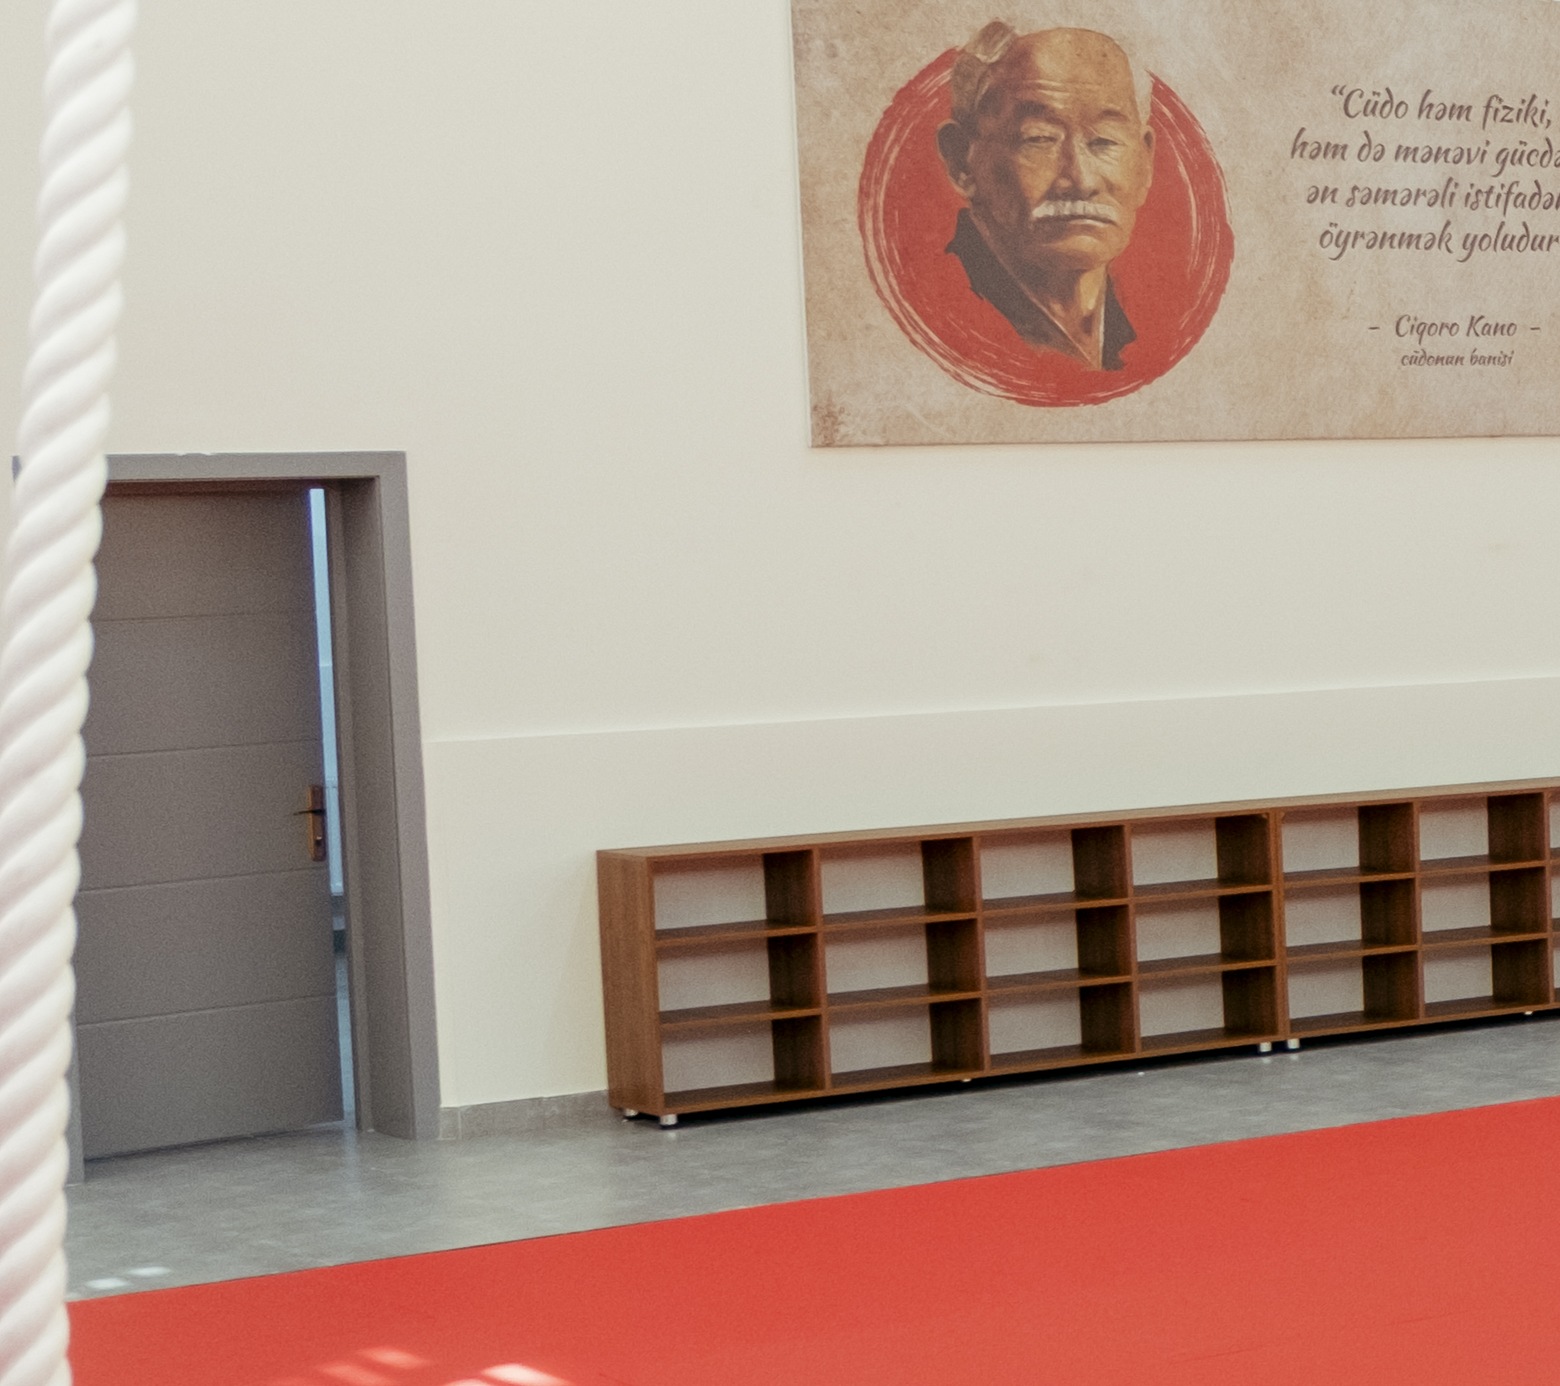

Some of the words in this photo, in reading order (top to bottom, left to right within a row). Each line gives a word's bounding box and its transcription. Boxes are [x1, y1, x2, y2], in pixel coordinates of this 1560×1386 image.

[1417, 89, 1472, 123] həm
[1482, 93, 1552, 130] fiziki,
[1290, 127, 1349, 162] həm
[1357, 130, 1386, 162] də
[1394, 139, 1490, 166] mənəvi
[1306, 184, 1339, 206] ən
[1345, 177, 1460, 210] səmərəli
[1318, 219, 1454, 261] öyrənmək
[1395, 314, 1460, 346] Ciqoro
[1466, 315, 1518, 338] Kano
[1469, 347, 1515, 367] banisi
